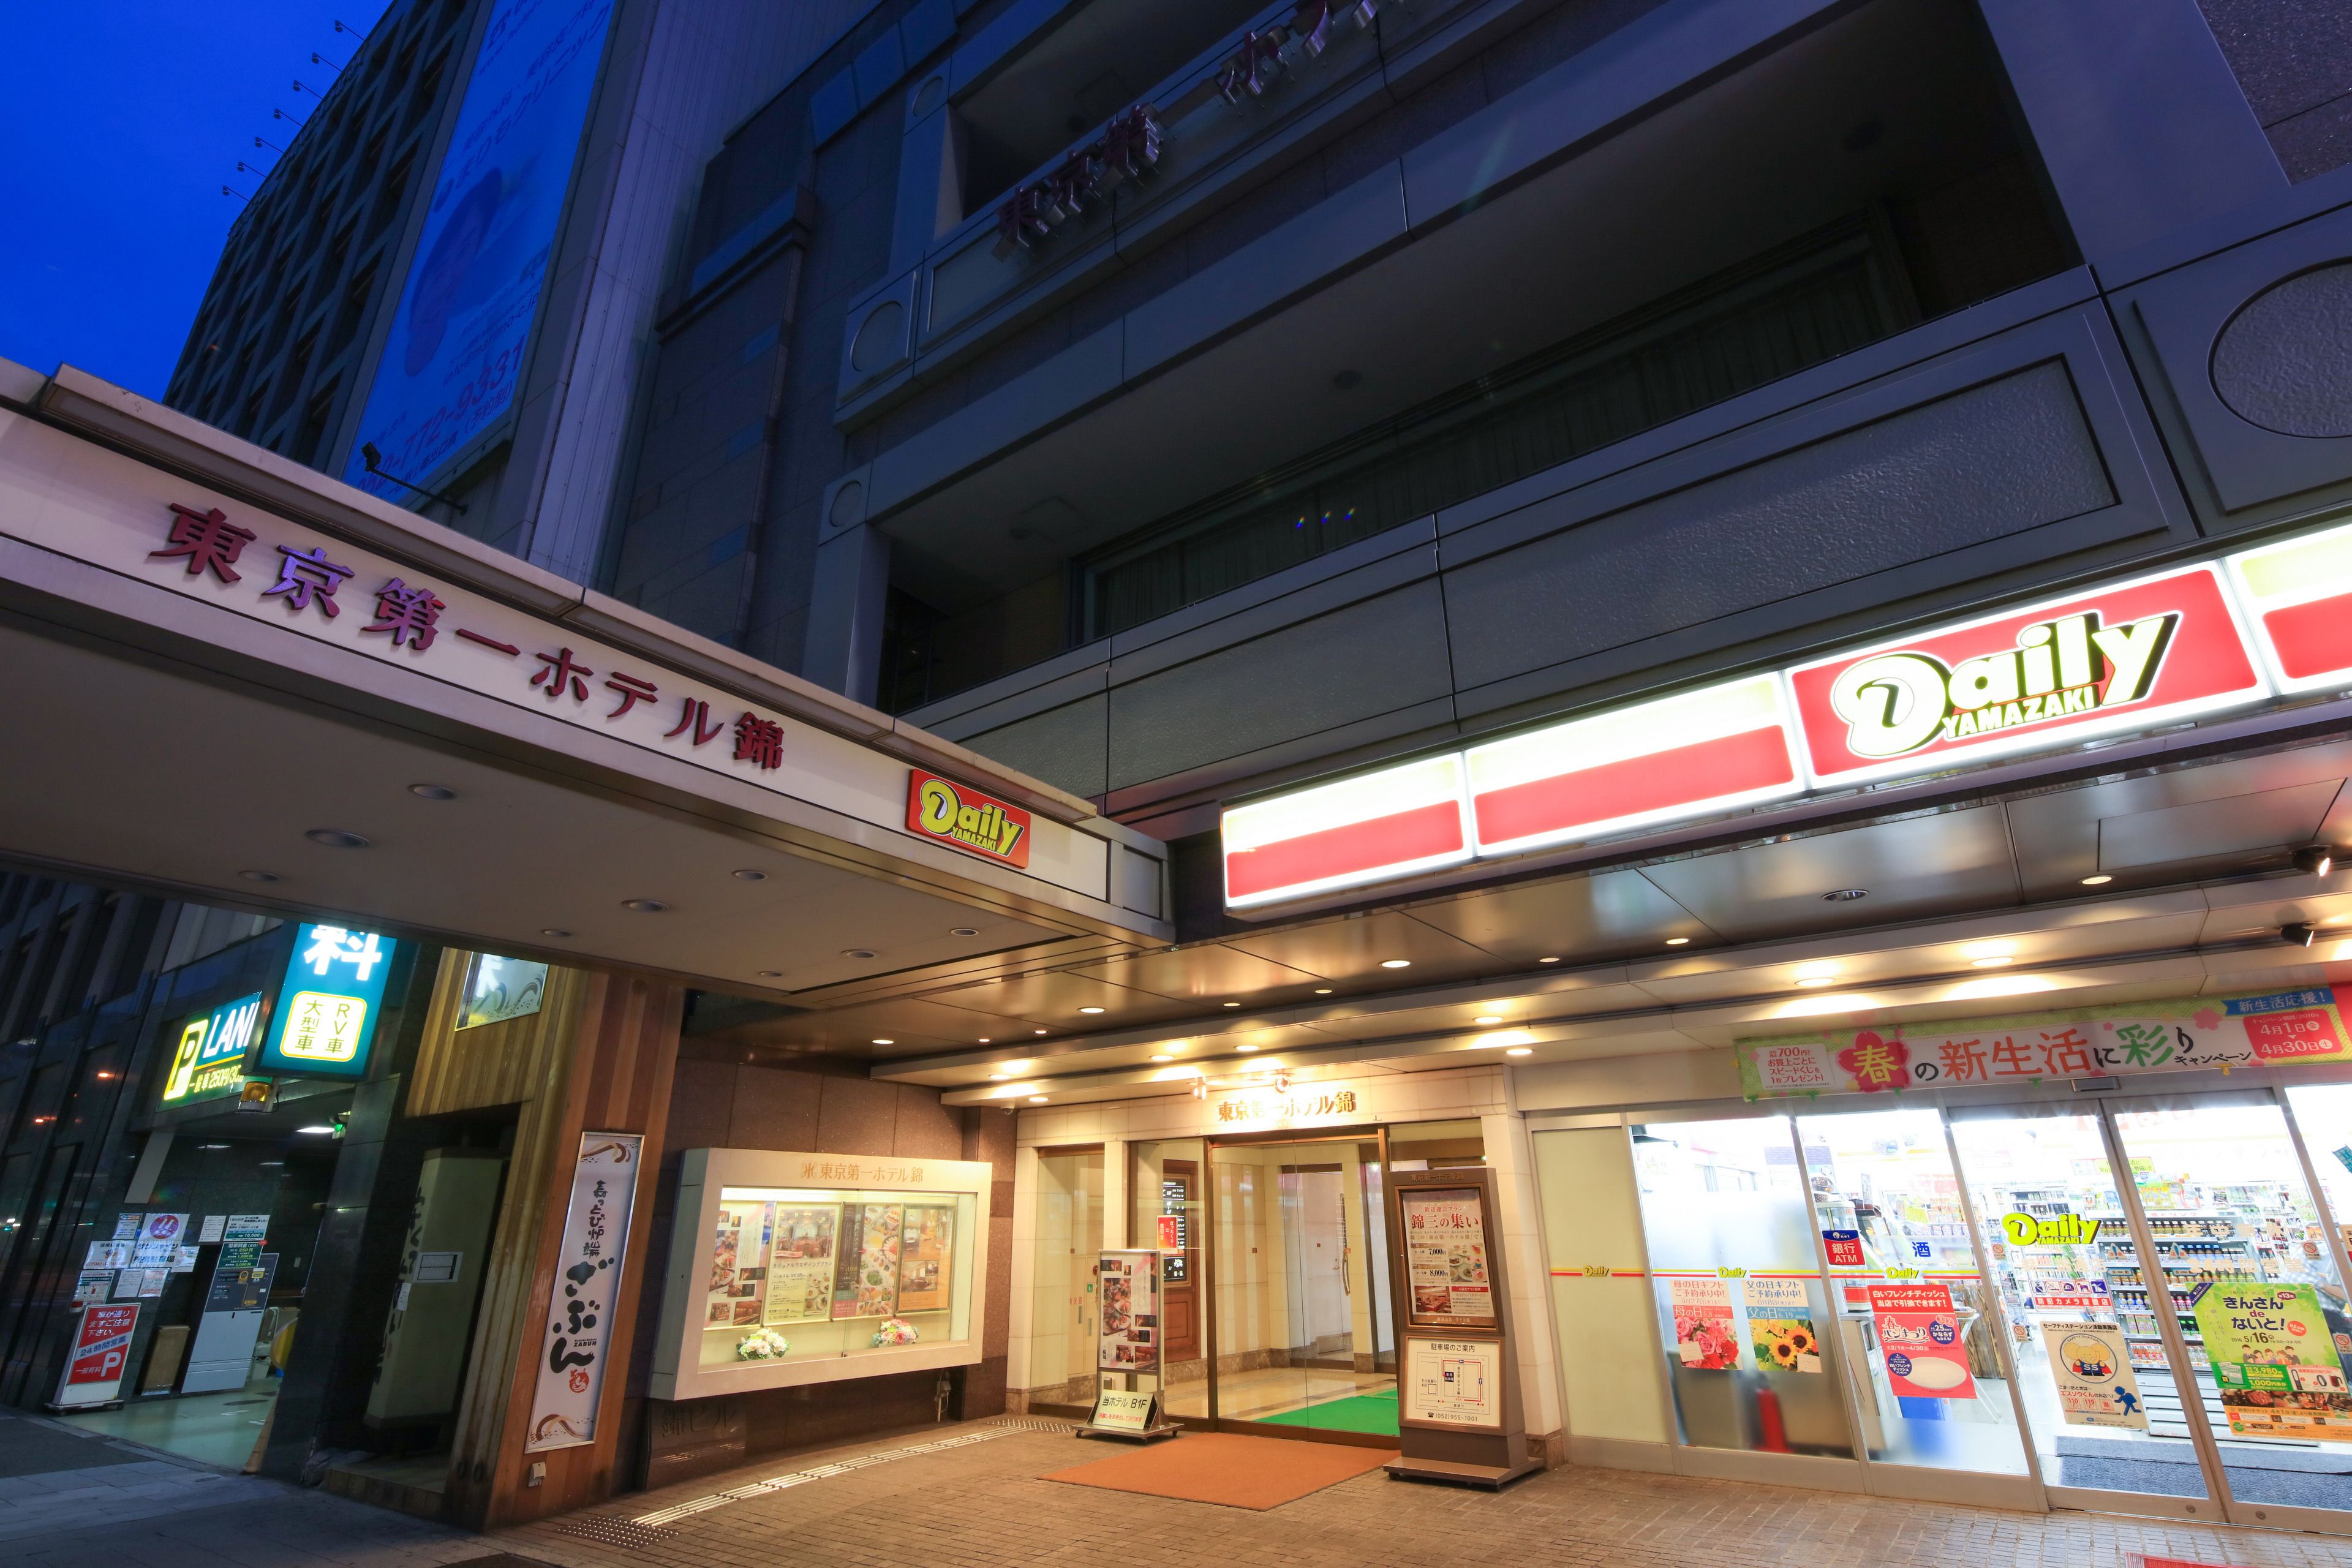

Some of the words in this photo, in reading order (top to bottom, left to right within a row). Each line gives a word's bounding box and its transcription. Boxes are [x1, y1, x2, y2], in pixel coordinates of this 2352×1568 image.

[150, 502, 785, 771] 東京第一ホテル錦
[1833, 612, 2179, 756] Daily
[1942, 686, 2095, 737] YAMAZAKI
[921, 780, 1023, 855] Daily
[952, 826, 997, 850] YAMAZAKI
[2237, 991, 2326, 1012] 新生活応援！
[295, 1000, 324, 1051] 大型車
[325, 1003, 350, 1053] RV車
[1768, 1057, 1817, 1067] お買上ごとに
[2174, 1050, 2252, 1066] キャンペーン
[1769, 1066, 1821, 1075] スピードくじを
[820, 1163, 924, 1183] 東京第一ホテル錦
[1411, 1171, 1464, 1182] 東京第一ホテル錦
[1411, 1213, 1479, 1229] 錦三の集い
[2002, 1212, 2101, 1246] Daily
[1831, 1243, 1855, 1254] 銀行
[1912, 1242, 1931, 1257] 酒
[1835, 1254, 1858, 1263] ATM
[1583, 1265, 1610, 1276] Daily
[1718, 1267, 1747, 1278] Daily
[1886, 1267, 1920, 1279] Daily
[1746, 1280, 1800, 1289] 父の日ギフト
[2223, 1297, 2284, 1310] きんさん
[97, 1310, 130, 1318] 車が通り
[1675, 1306, 1702, 1317] 母の日
[1748, 1307, 1777, 1319] 父の日
[88, 1318, 132, 1328] ますご注意
[2244, 1332, 2269, 1344] 5/16
[80, 1335, 127, 1357] 24時間営業
[1431, 1343, 1475, 1352] 駐車場のご案内
[76, 1365, 102, 1374] 一般有料
[100, 1352, 122, 1377] P
[1102, 1396, 1128, 1407] 当ホテル
[1131, 1398, 1147, 1409] B1F
